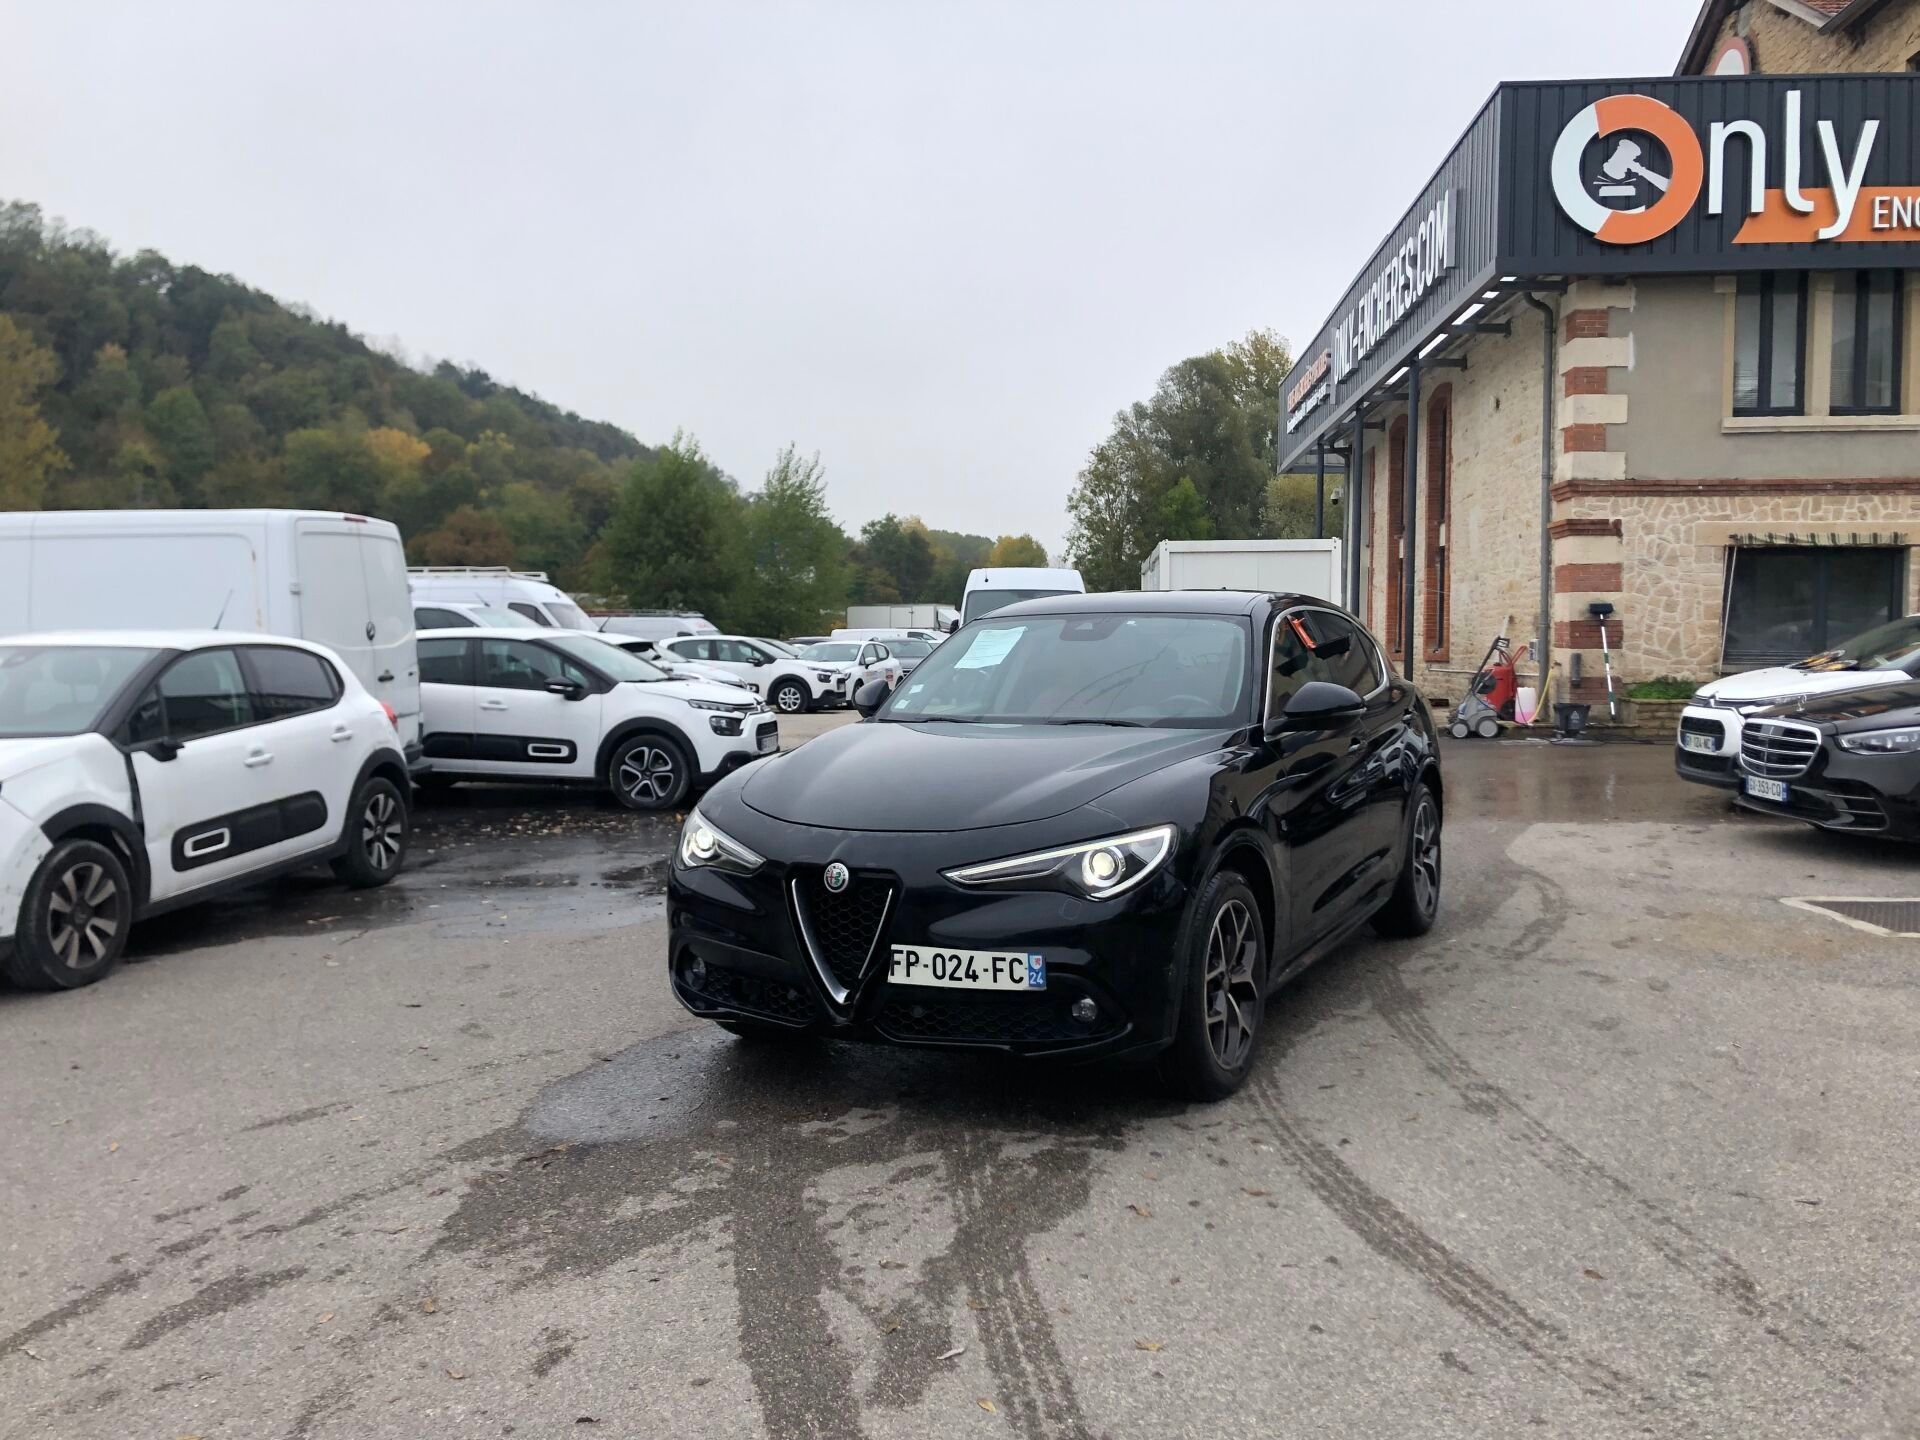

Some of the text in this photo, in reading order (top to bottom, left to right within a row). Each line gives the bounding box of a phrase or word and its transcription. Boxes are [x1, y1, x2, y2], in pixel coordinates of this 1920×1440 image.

[1551, 89, 1881, 245] Only
[1334, 188, 1452, 385] ONLY-ENCHERES.COM
[889, 949, 1045, 986] FP-024-FC 24
